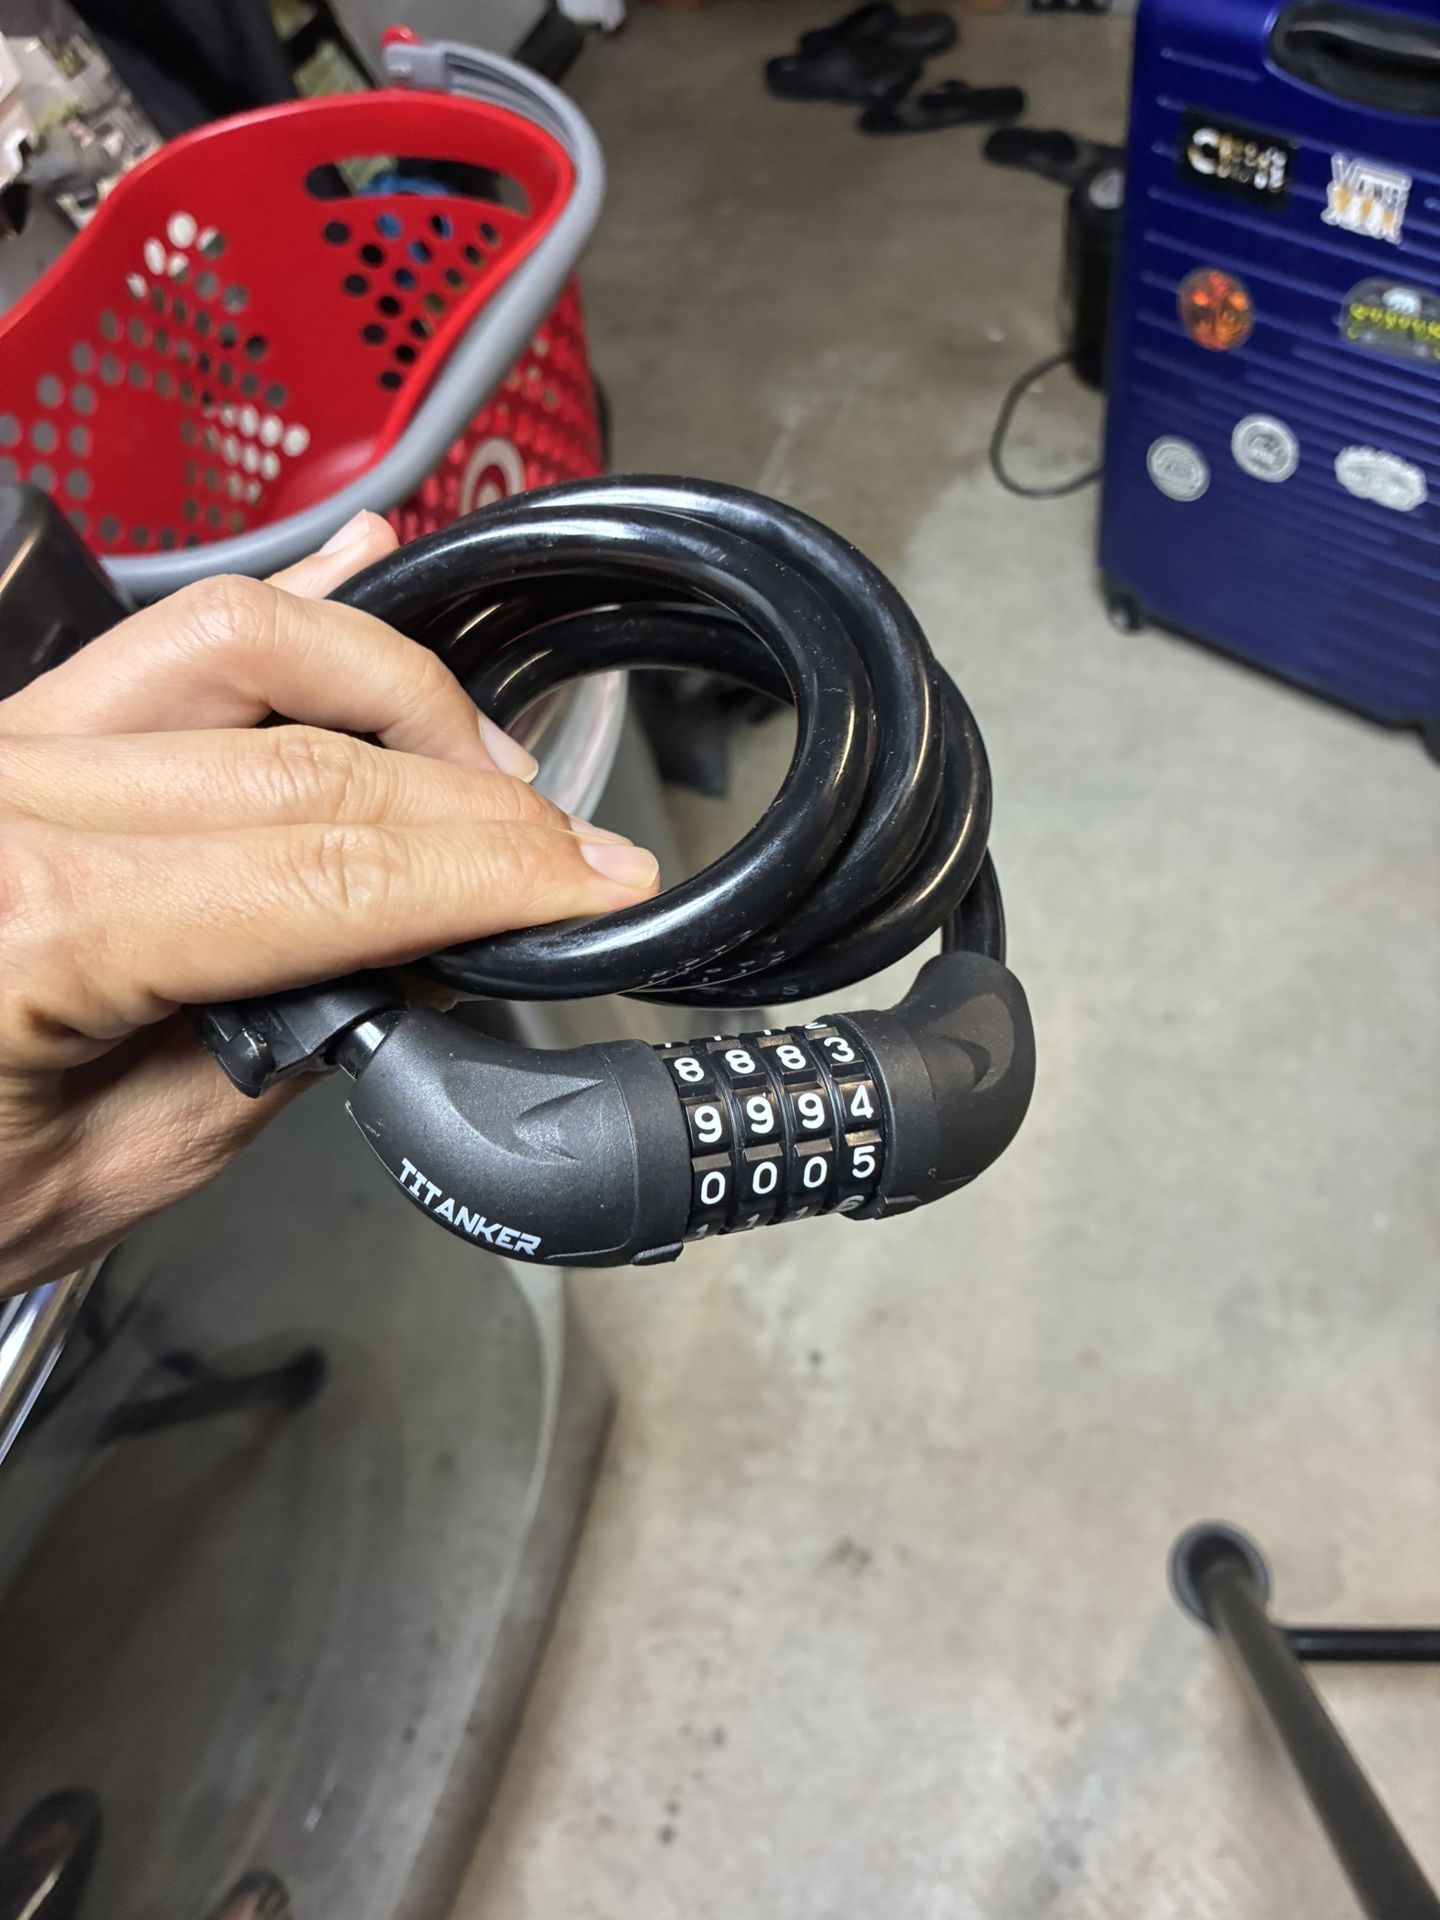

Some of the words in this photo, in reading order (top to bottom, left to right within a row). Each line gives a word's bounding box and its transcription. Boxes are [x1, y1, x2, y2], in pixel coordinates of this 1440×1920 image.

[674, 1057, 705, 1082] 8
[725, 1049, 756, 1074] 8
[776, 1045, 807, 1070] 8
[823, 1036, 855, 1063] 3
[694, 1105, 723, 1143] 9
[746, 1096, 774, 1134] 9
[797, 1092, 825, 1129] 9
[850, 1084, 874, 1119] 4
[700, 1171, 726, 1205] 0
[752, 1161, 778, 1194] 0
[803, 1156, 827, 1188] 0
[852, 1145, 876, 1178] 5
[400, 1157, 542, 1256] TITANKER
